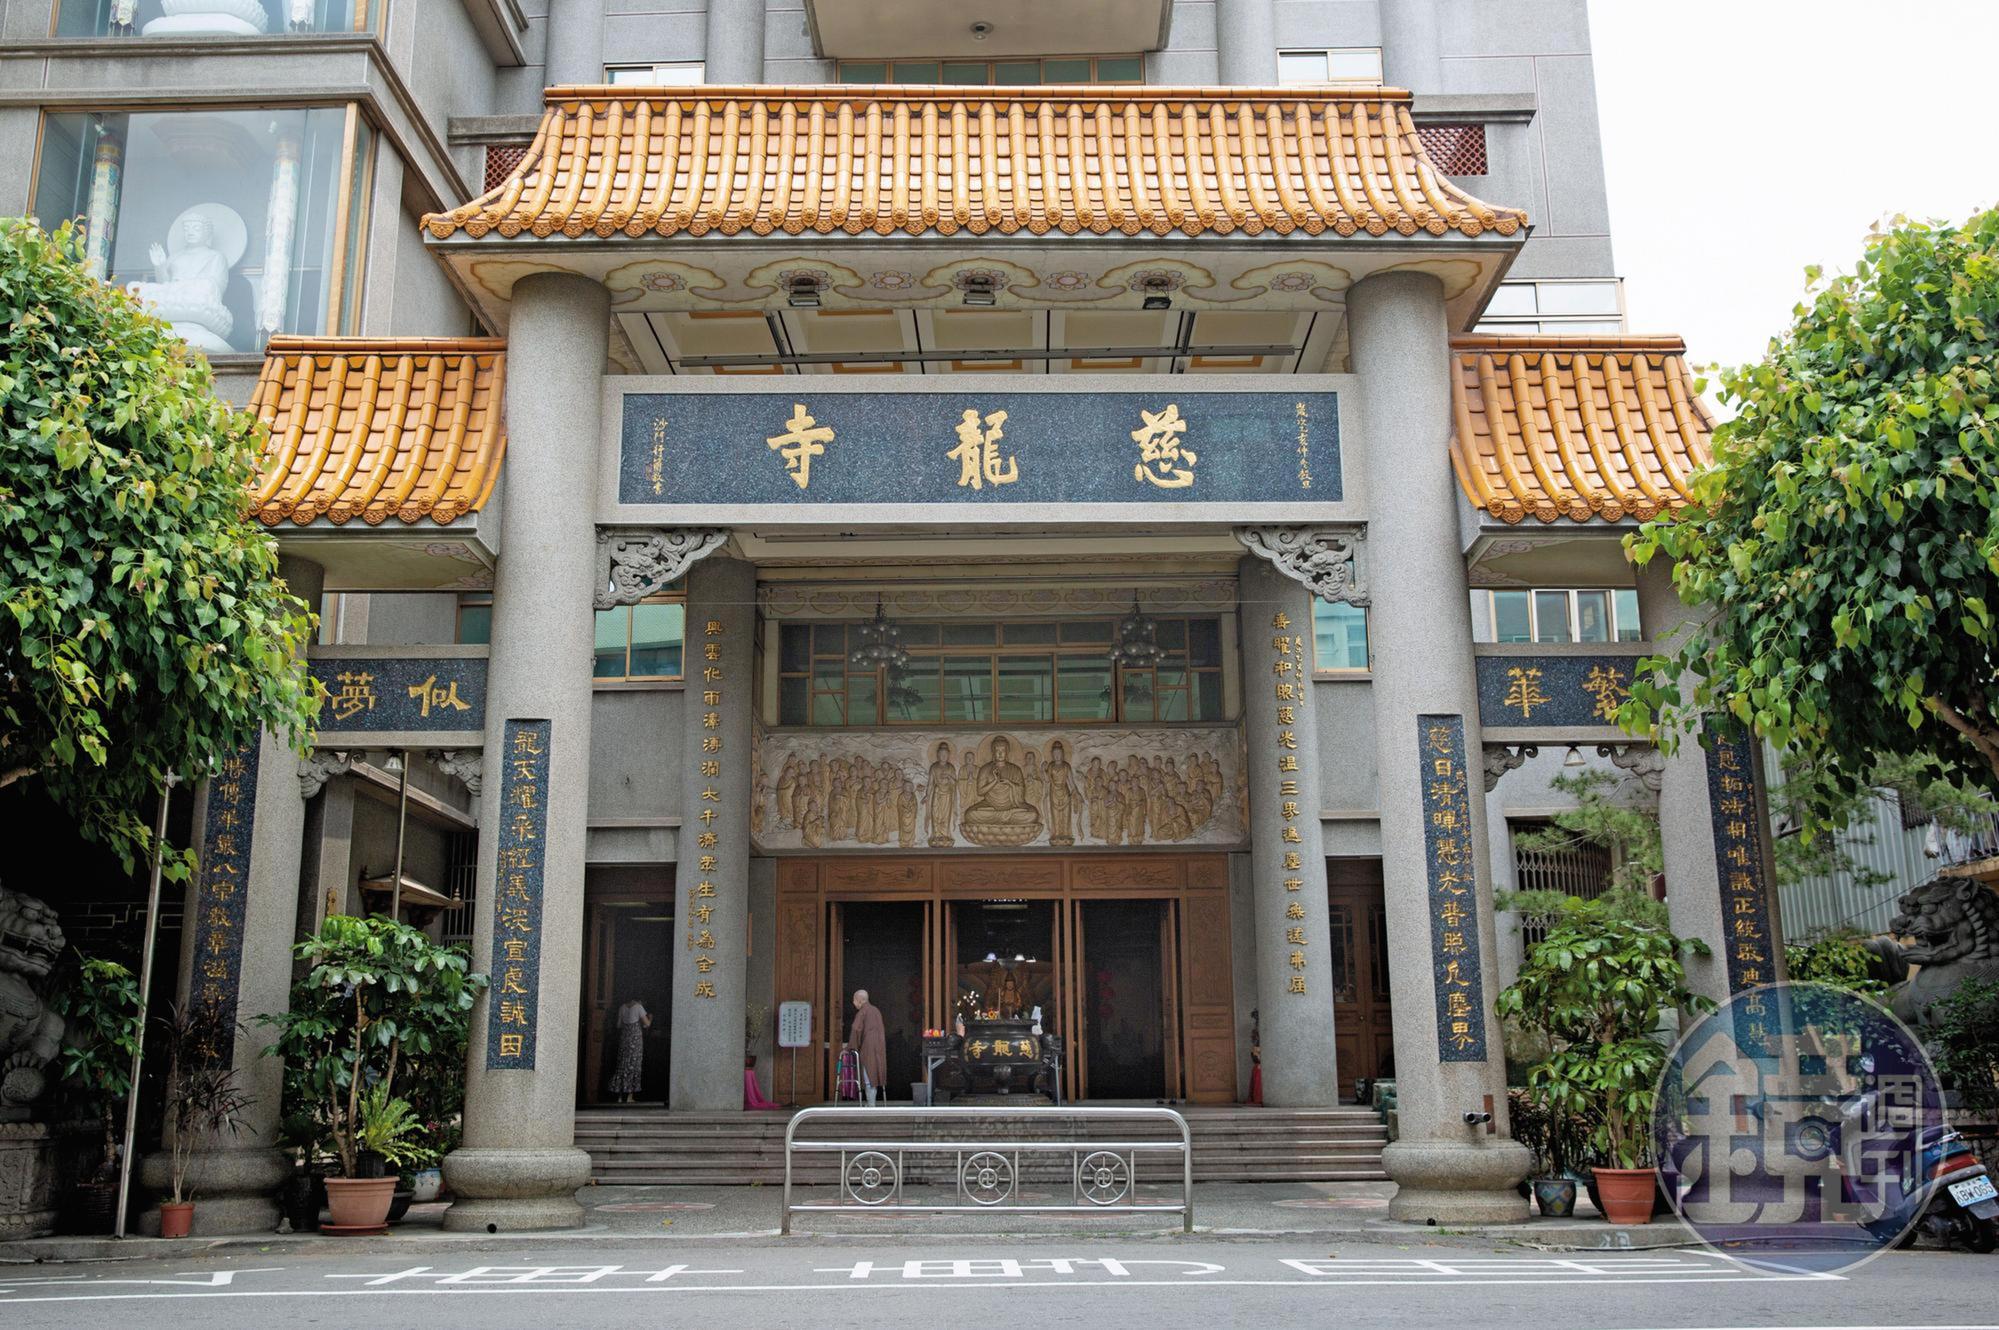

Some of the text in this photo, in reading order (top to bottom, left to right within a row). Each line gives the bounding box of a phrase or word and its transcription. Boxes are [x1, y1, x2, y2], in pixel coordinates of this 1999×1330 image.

[767, 403, 1197, 489] 慈龍寺
[969, 1039, 1034, 1060] 慈龍寺
